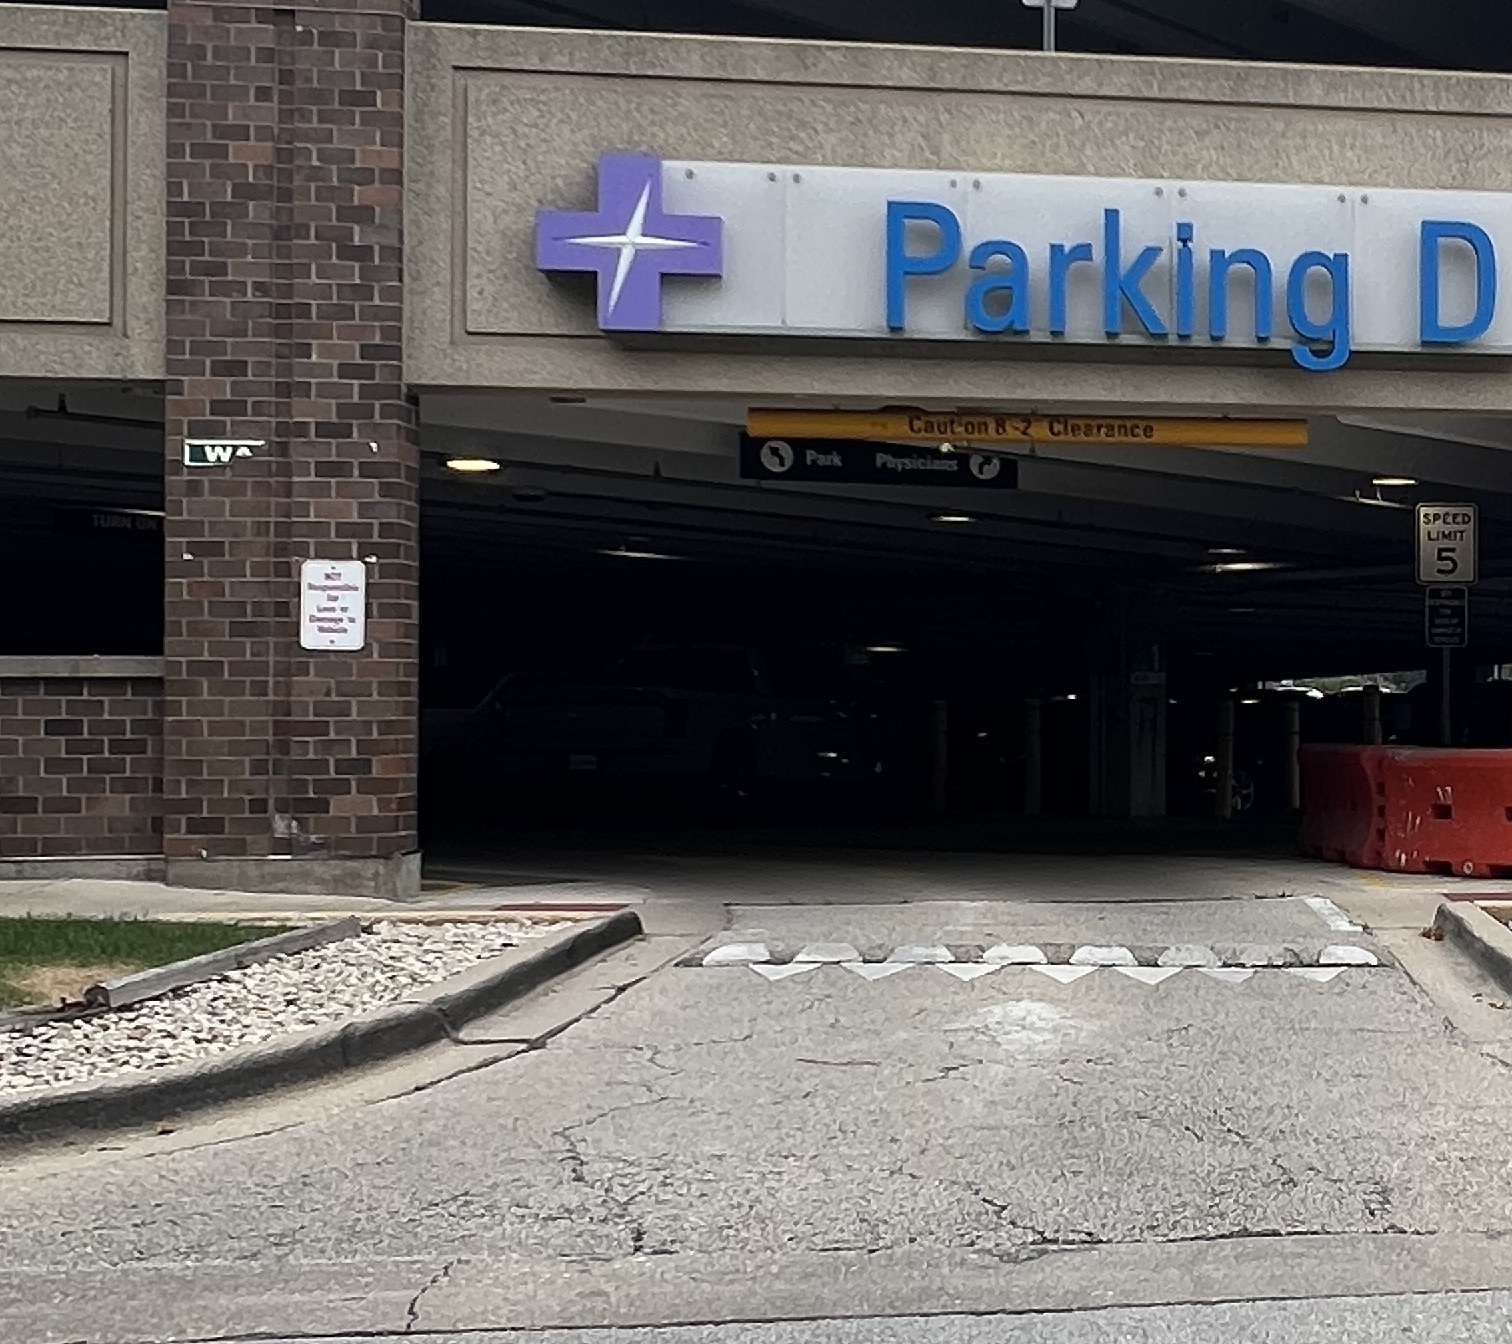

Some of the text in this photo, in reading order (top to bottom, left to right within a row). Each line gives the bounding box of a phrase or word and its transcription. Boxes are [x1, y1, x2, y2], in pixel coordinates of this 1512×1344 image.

[886, 200, 1497, 372] Parking D
[1047, 417, 1154, 439] Clearance
[806, 449, 959, 472] Park Physicians
[1422, 511, 1472, 526] SPEED
[1426, 529, 1466, 542] LIMIT
[1436, 546, 1459, 576] 5
